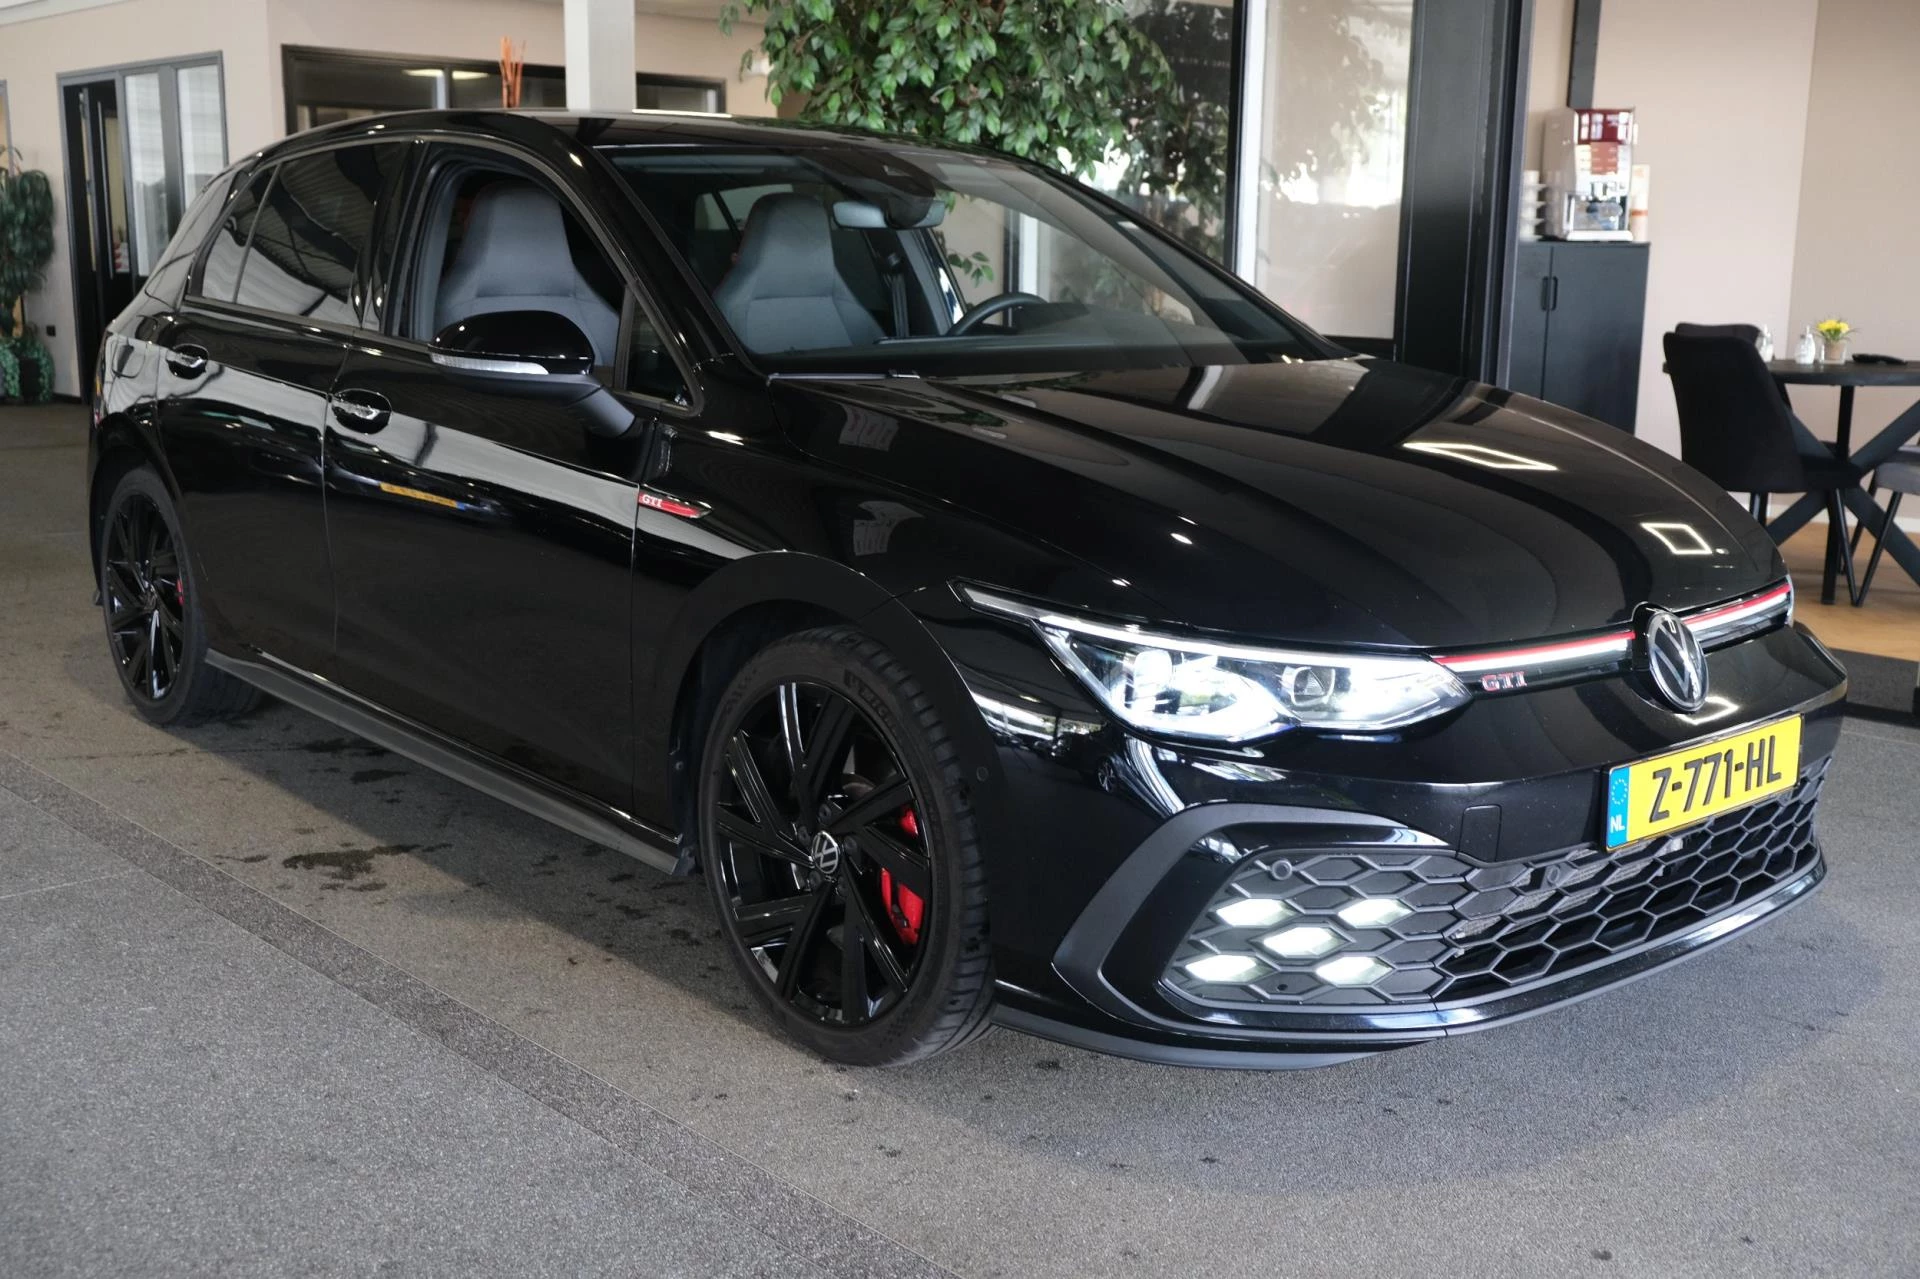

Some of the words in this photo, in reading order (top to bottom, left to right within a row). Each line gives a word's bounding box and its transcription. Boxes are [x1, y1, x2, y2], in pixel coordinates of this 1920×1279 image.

[642, 494, 663, 508] GTI
[1481, 671, 1528, 692] GTI
[1649, 735, 1782, 823] Z-771-HL
[1610, 814, 1625, 833] NL
